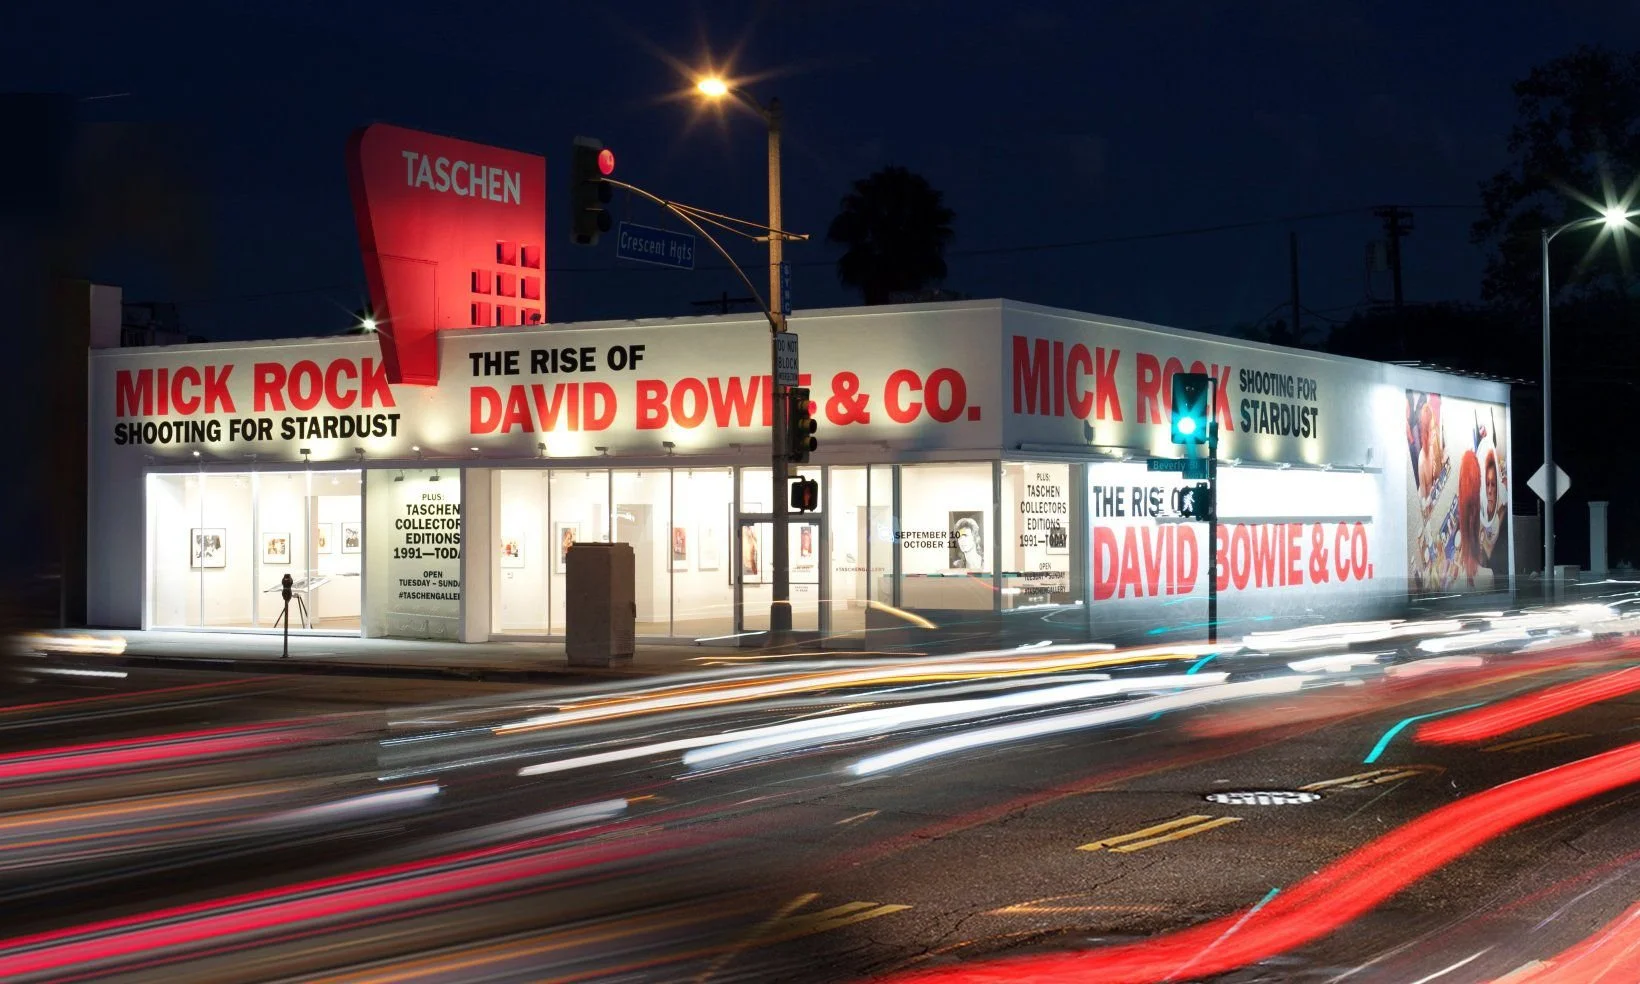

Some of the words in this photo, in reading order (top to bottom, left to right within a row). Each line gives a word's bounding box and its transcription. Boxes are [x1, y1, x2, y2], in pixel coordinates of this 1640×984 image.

[402, 150, 520, 205] TASCHEN
[621, 231, 665, 256] Crescent
[670, 240, 692, 264] Hgts
[777, 340, 785, 352] DO
[787, 340, 797, 353] NOT
[469, 351, 520, 376] THE
[530, 346, 596, 375] RISE
[607, 344, 646, 371] OF
[778, 356, 798, 369] BLOCK
[1012, 335, 1124, 422] MICK
[1239, 368, 1294, 401] SHOOTING
[1297, 375, 1317, 402] FOR
[116, 364, 236, 417] MICK
[254, 357, 396, 412] ROCK
[469, 381, 617, 434] DAVID
[825, 372, 871, 425] &
[884, 367, 981, 423] CO.
[1240, 399, 1318, 439] STARDUST
[114, 419, 222, 445] SHOOTING
[229, 417, 273, 441] FOR
[281, 413, 400, 440] STARDUST
[1153, 460, 1186, 471] Beverly
[1036, 472, 1051, 481] PLUS:
[422, 493, 445, 501] PLUS:
[1027, 485, 1060, 498] TASCHEN
[1020, 501, 1067, 514] COLLECTORS
[1093, 486, 1125, 517] THE
[406, 503, 460, 515] TASCHEN
[1027, 518, 1061, 531] EDITIONS
[406, 533, 460, 545] EDITIONS
[895, 531, 947, 539] SEPTEMBER
[950, 530, 960, 539] 10
[903, 541, 944, 549] OCTOBER
[947, 541, 957, 549] 11
[1039, 562, 1051, 571] OPEN
[1093, 525, 1198, 600] DAVID
[1215, 522, 1303, 592] BOWIE
[1309, 522, 1329, 584] &
[1335, 521, 1373, 582] CO.
[399, 579, 431, 587] TUESDAY
